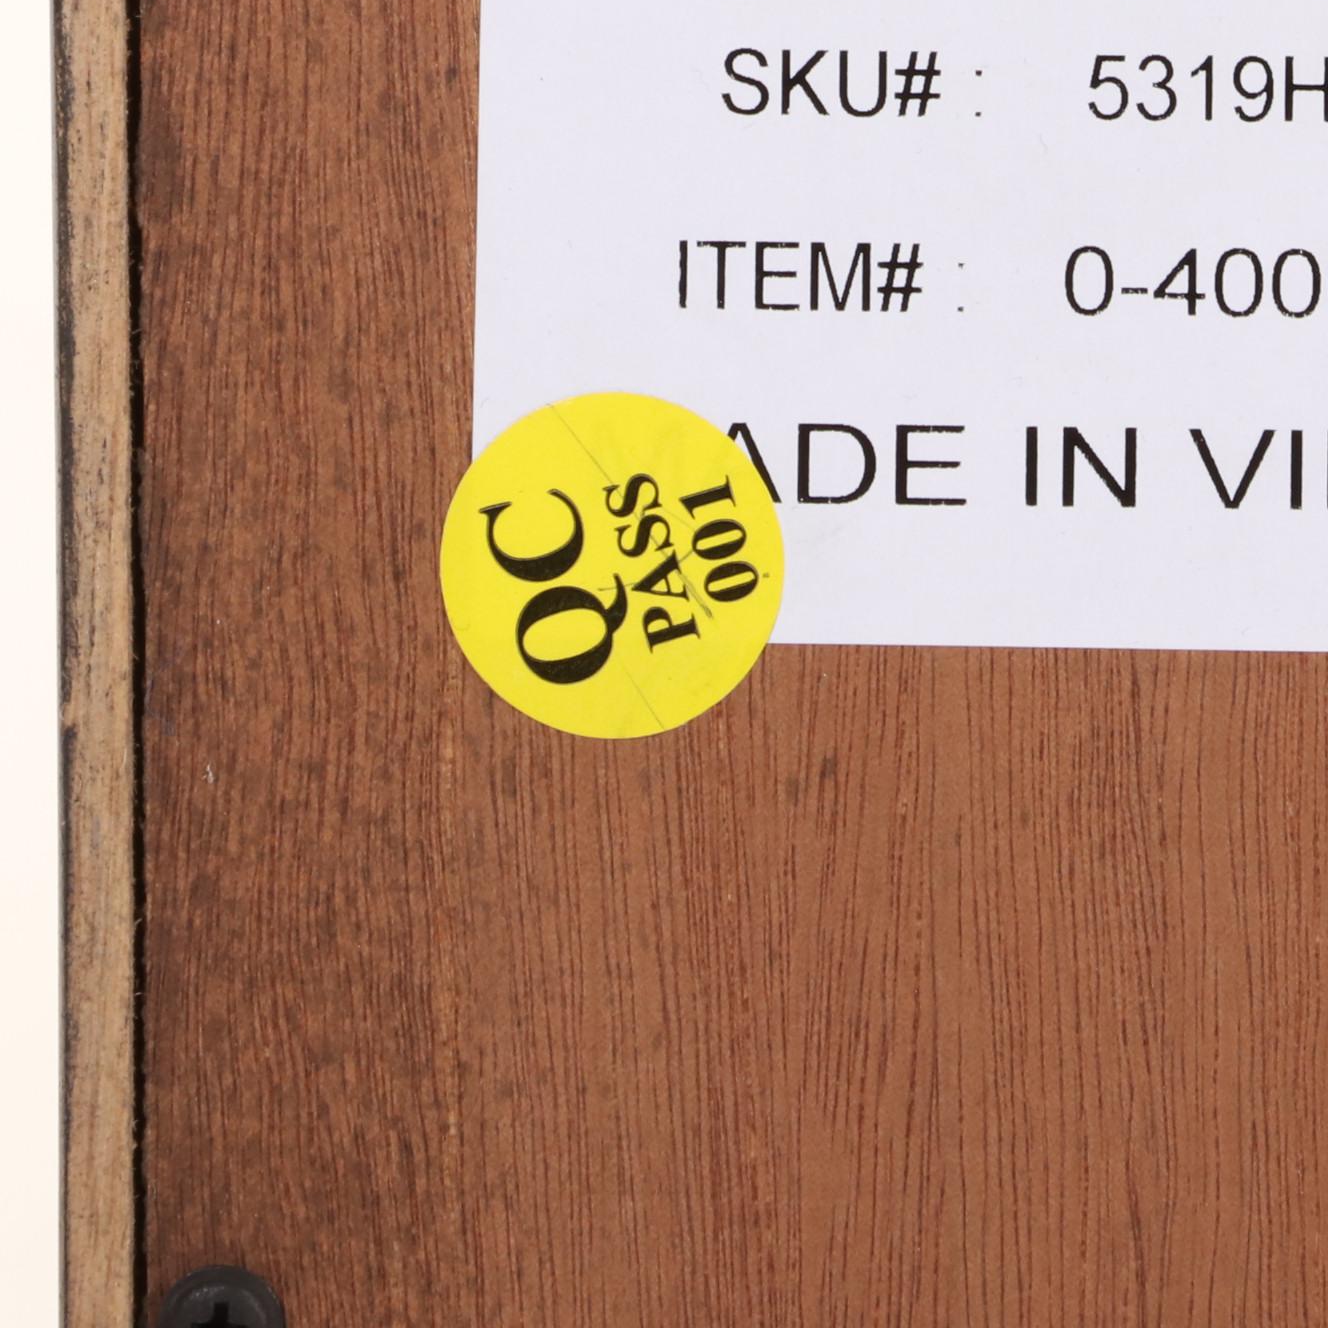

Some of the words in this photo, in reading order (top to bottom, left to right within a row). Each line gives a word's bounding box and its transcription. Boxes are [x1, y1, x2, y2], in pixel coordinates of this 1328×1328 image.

[722, 48, 941, 117] SKU#
[679, 240, 923, 312] ITEM#
[1026, 427, 1137, 507] IN
[478, 488, 628, 685] QC
[602, 473, 702, 654] PASS
[679, 475, 760, 603] 001
